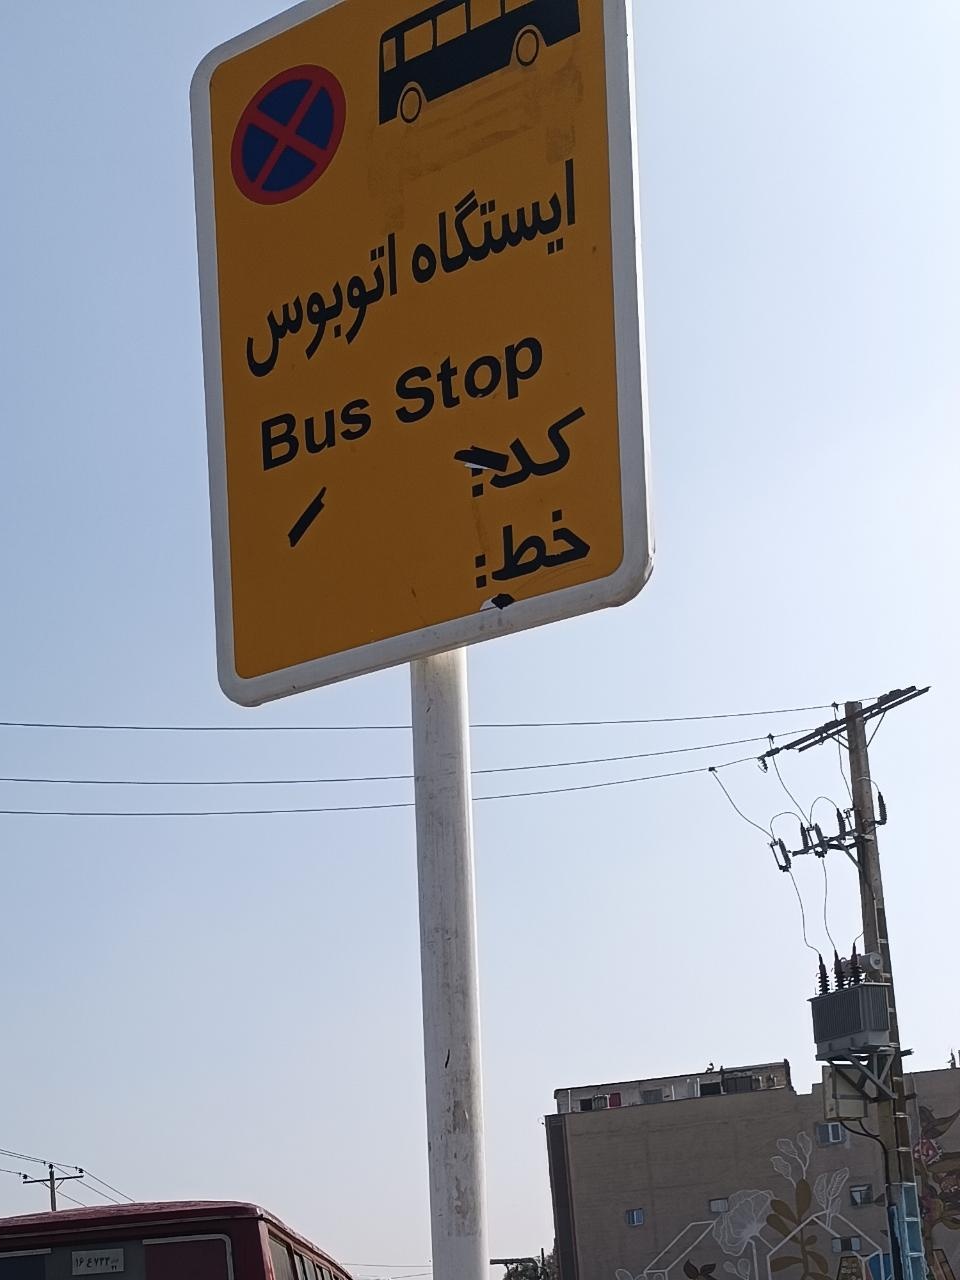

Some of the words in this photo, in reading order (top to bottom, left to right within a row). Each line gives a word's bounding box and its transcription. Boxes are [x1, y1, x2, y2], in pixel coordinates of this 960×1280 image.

[411, 158, 577, 284] ایستگاه
[246, 233, 398, 378] اتوبوس
[261, 399, 373, 472] Bus
[395, 336, 543, 424] Stop
[474, 509, 591, 589] خط:
